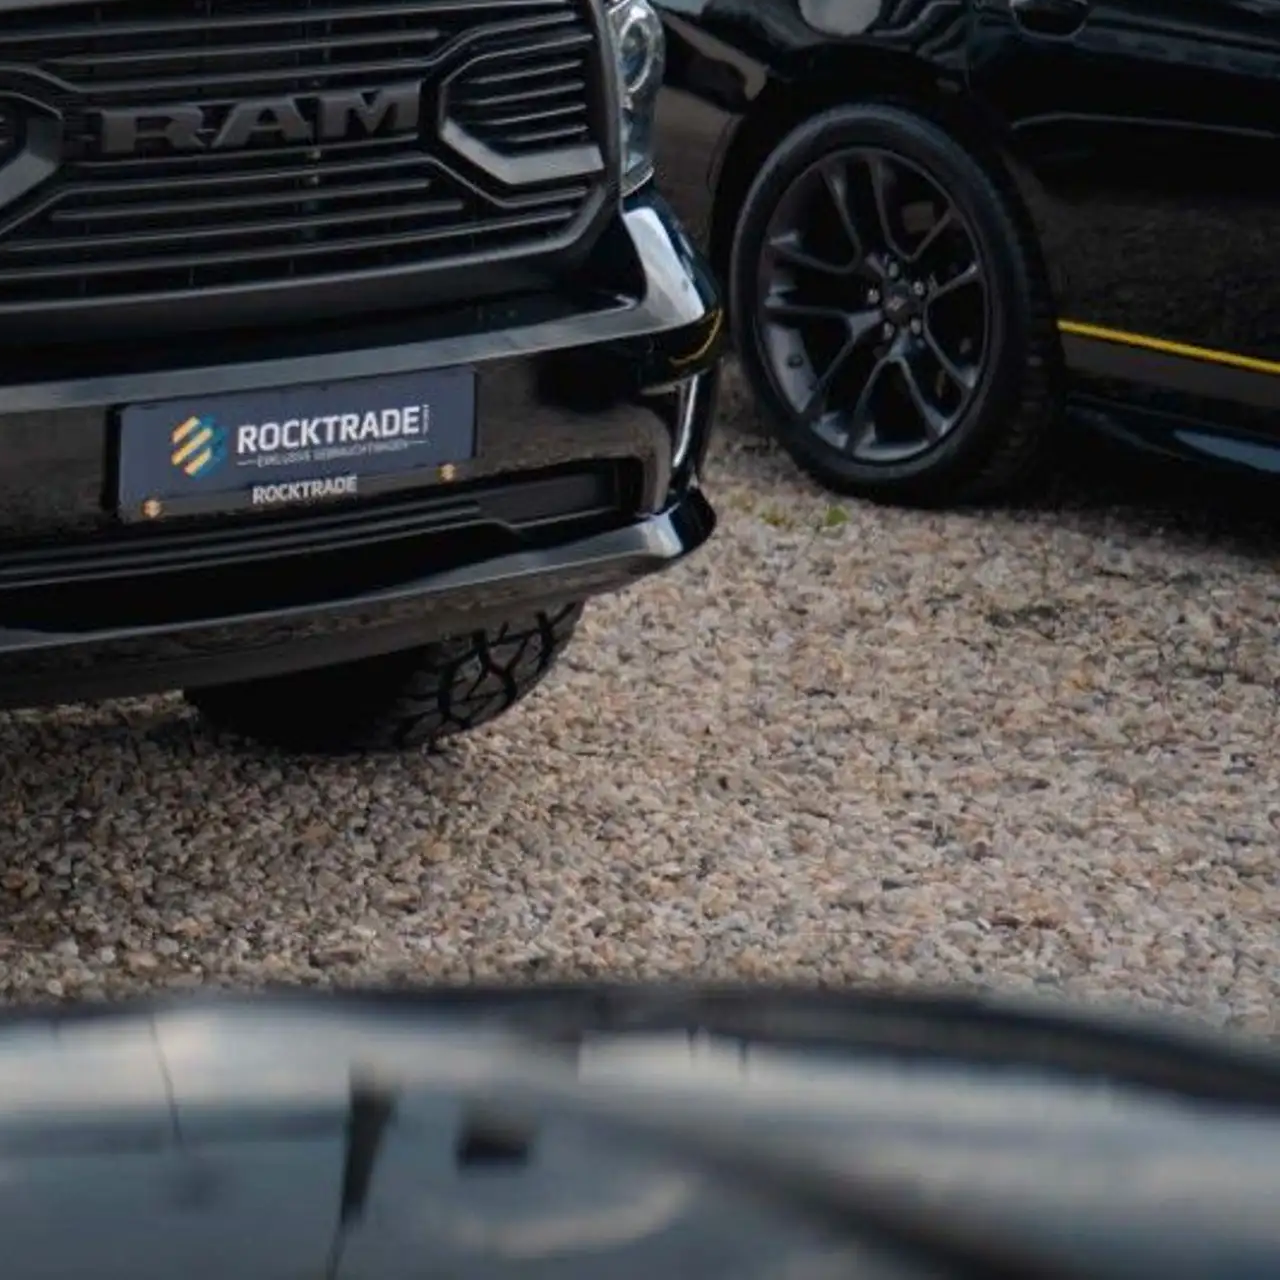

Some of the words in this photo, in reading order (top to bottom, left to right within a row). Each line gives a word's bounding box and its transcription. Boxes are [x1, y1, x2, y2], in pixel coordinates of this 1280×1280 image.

[100, 79, 422, 154] RAM
[236, 405, 421, 455] ROCKTRADE
[251, 474, 358, 505] ROCKTRADE
